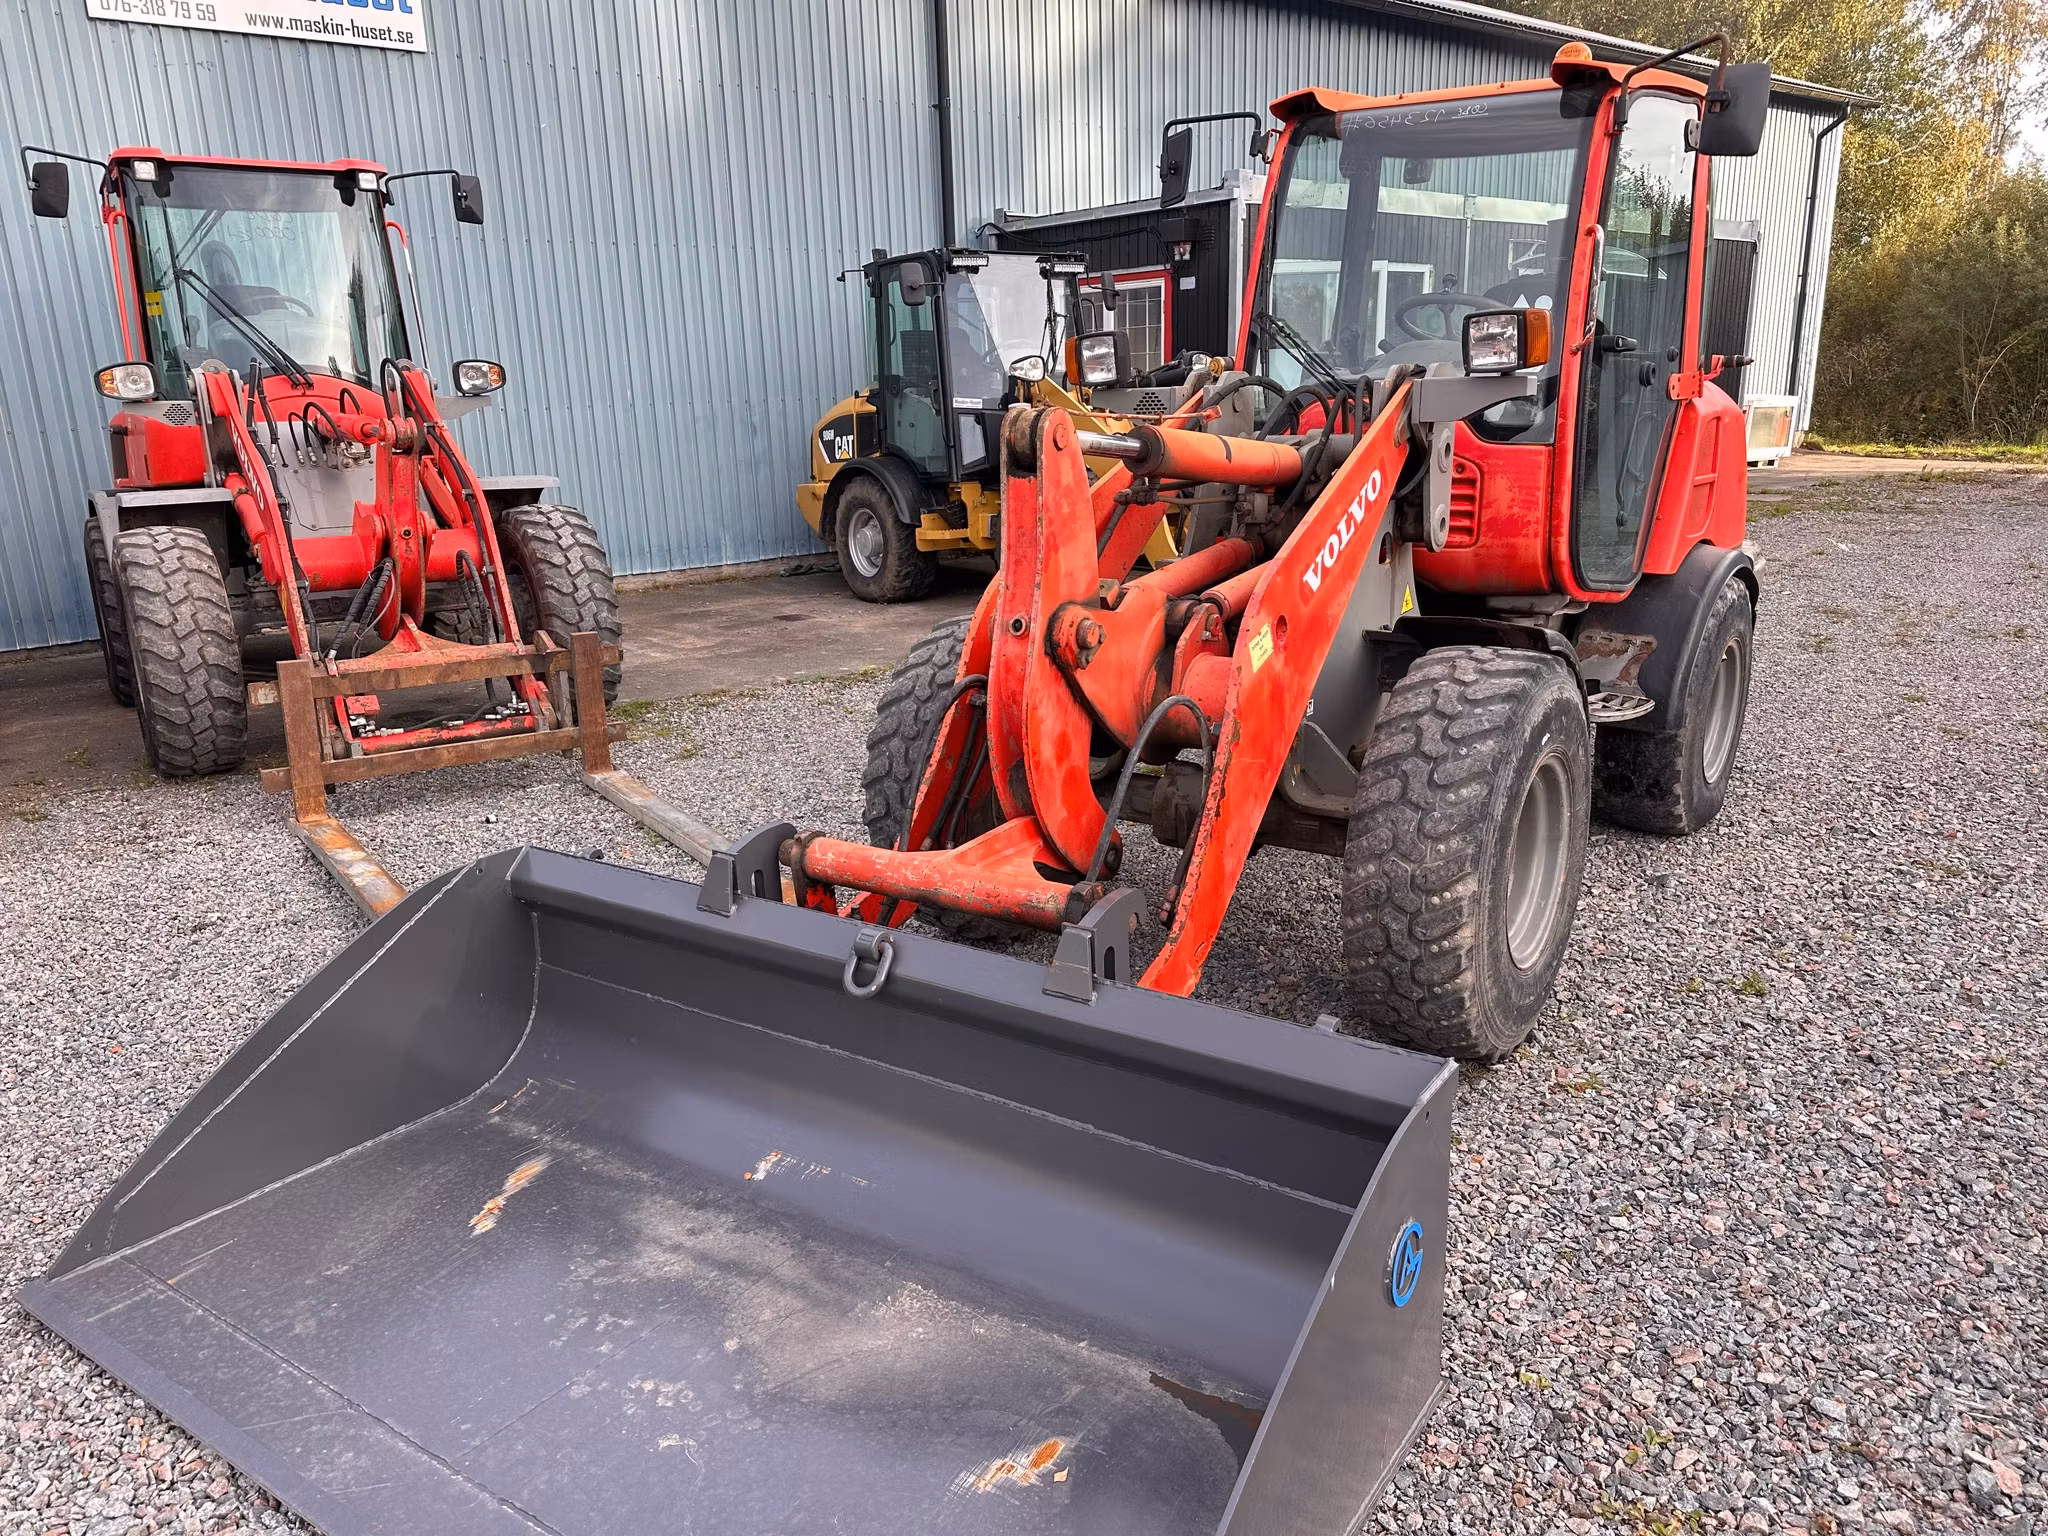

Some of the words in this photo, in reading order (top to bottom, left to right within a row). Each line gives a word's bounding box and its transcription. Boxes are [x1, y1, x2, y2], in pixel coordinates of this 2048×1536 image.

[170, 0, 192, 19] 79
[196, 3, 217, 22] 59
[245, 12, 414, 44] www.maskin-huset.se
[834, 435, 854, 460] CAT
[1303, 469, 1382, 592] VOLVO
